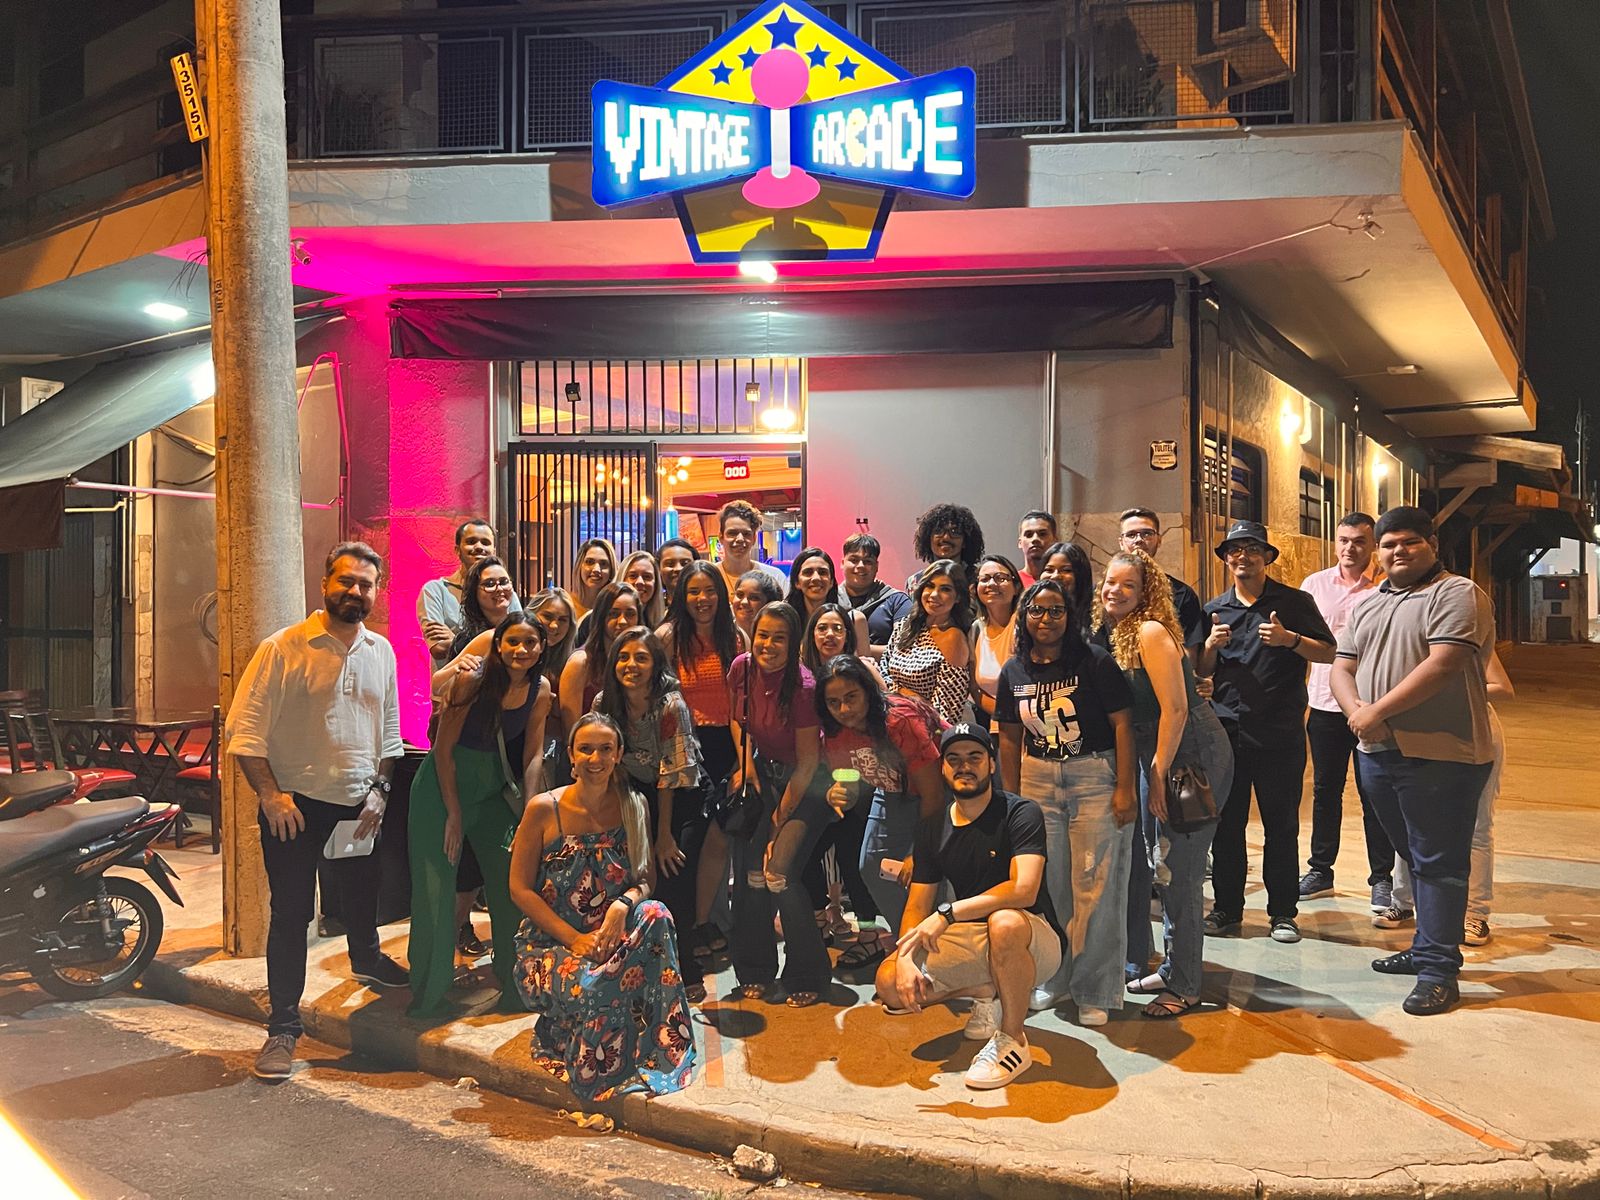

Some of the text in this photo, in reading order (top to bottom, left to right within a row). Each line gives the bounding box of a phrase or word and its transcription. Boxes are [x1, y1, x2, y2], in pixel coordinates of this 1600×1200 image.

[177, 56, 203, 136] 135151
[604, 91, 963, 184] VINTAGE ARCADE
[725, 466, 747, 478] 000
[955, 723, 969, 734] NY
